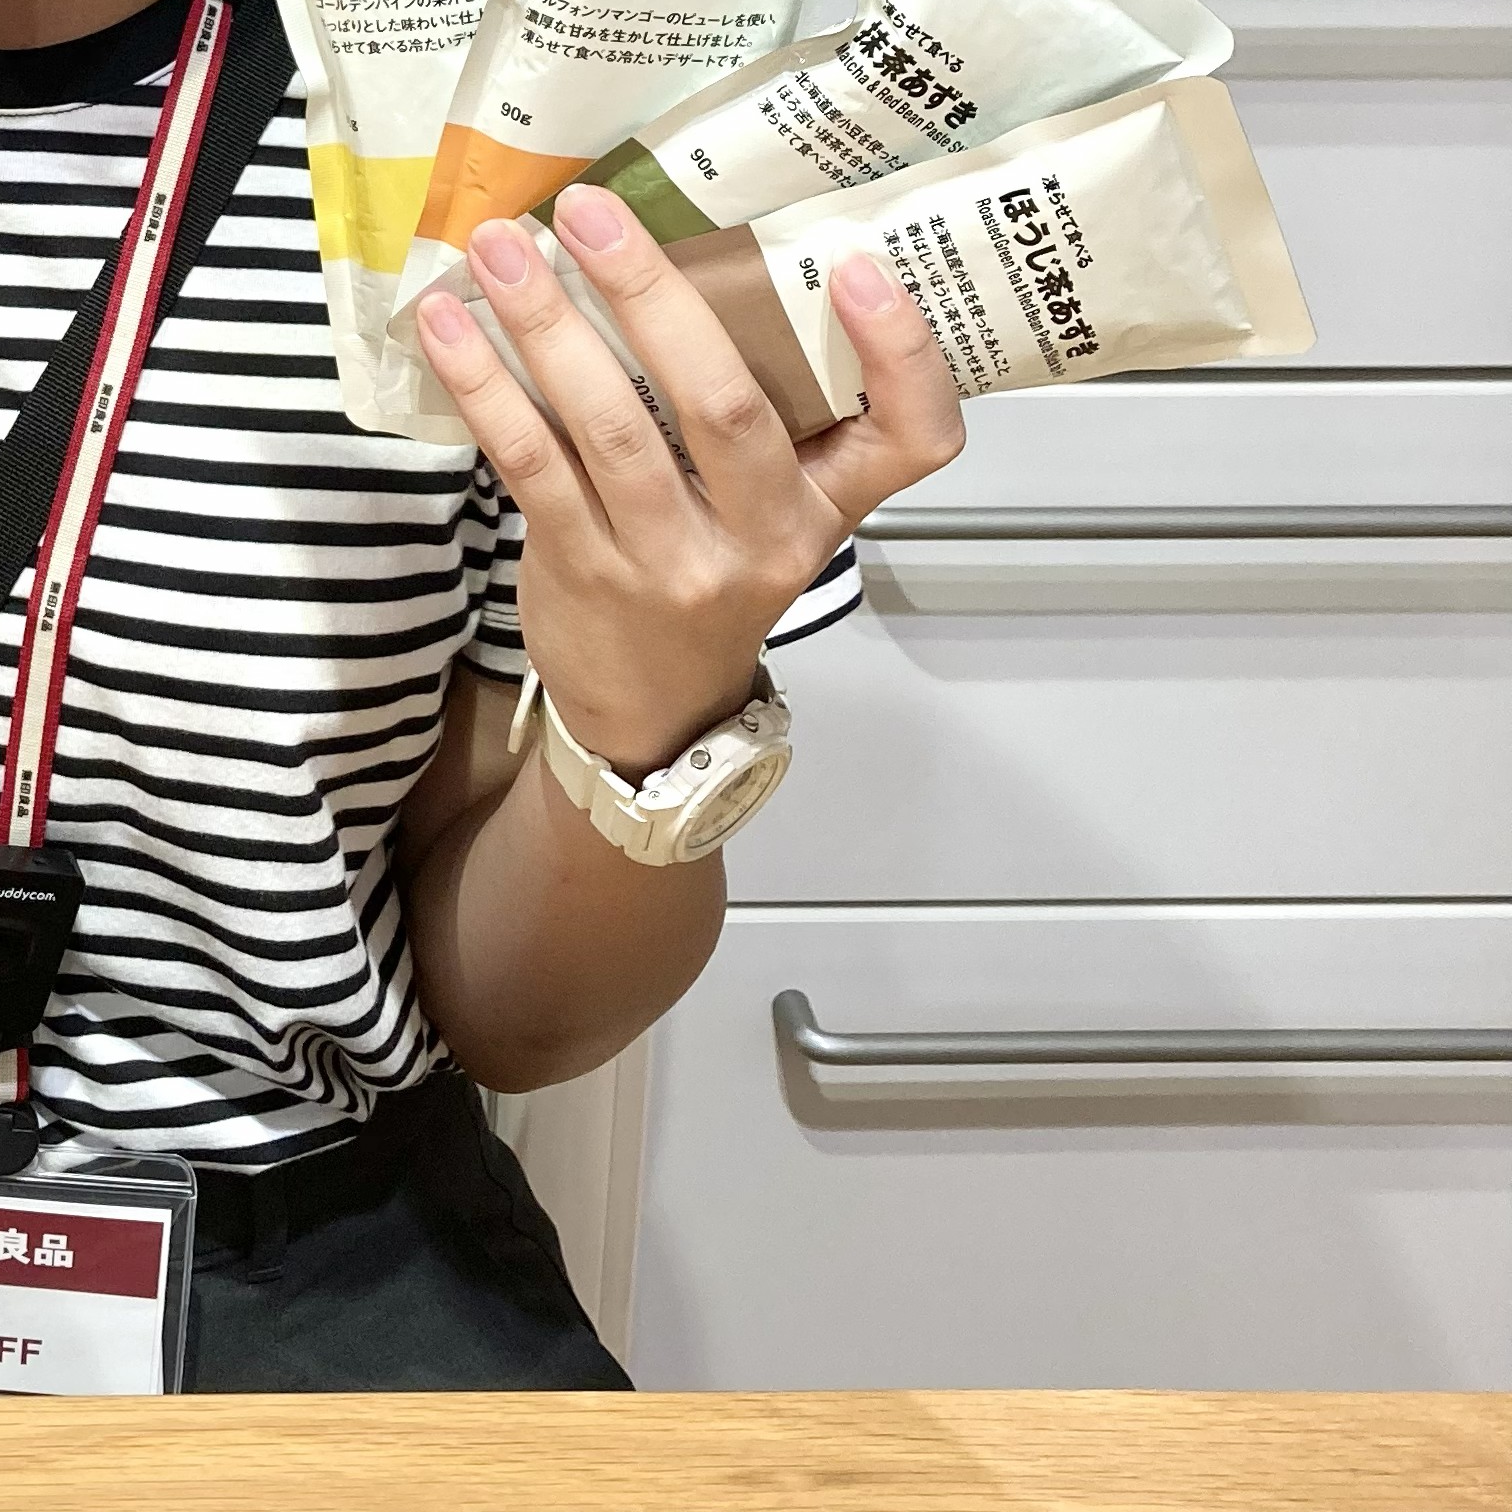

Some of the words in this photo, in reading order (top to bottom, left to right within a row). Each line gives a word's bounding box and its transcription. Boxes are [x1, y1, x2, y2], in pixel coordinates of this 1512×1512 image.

[524, 7, 753, 48] 濃厚な甘みを生かして仕上げました。
[520, 27, 745, 69] 凍らせて食べる冷たいデザートです。
[853, 20, 979, 130] 抹茶あずき
[500, 101, 533, 127] 90g
[835, 42, 870, 85] Matcha
[866, 79, 881, 94] &
[874, 86, 904, 110] Red
[895, 100, 925, 128] Bean
[919, 120, 950, 149] Paste
[690, 147, 720, 181] 90g
[975, 197, 1007, 242] Roasted
[1041, 173, 1094, 269] 凍らせて食べる
[993, 239, 1015, 270] Green
[998, 187, 1101, 359] ほうじ茶あずき
[799, 257, 822, 291] 90g
[1007, 266, 1024, 288] Tea
[1013, 283, 1030, 295] &
[928, 213, 1012, 377] 北海道産小豆を使ったあんこと
[1016, 289, 1038, 312] Red
[1024, 307, 1045, 334] Bean
